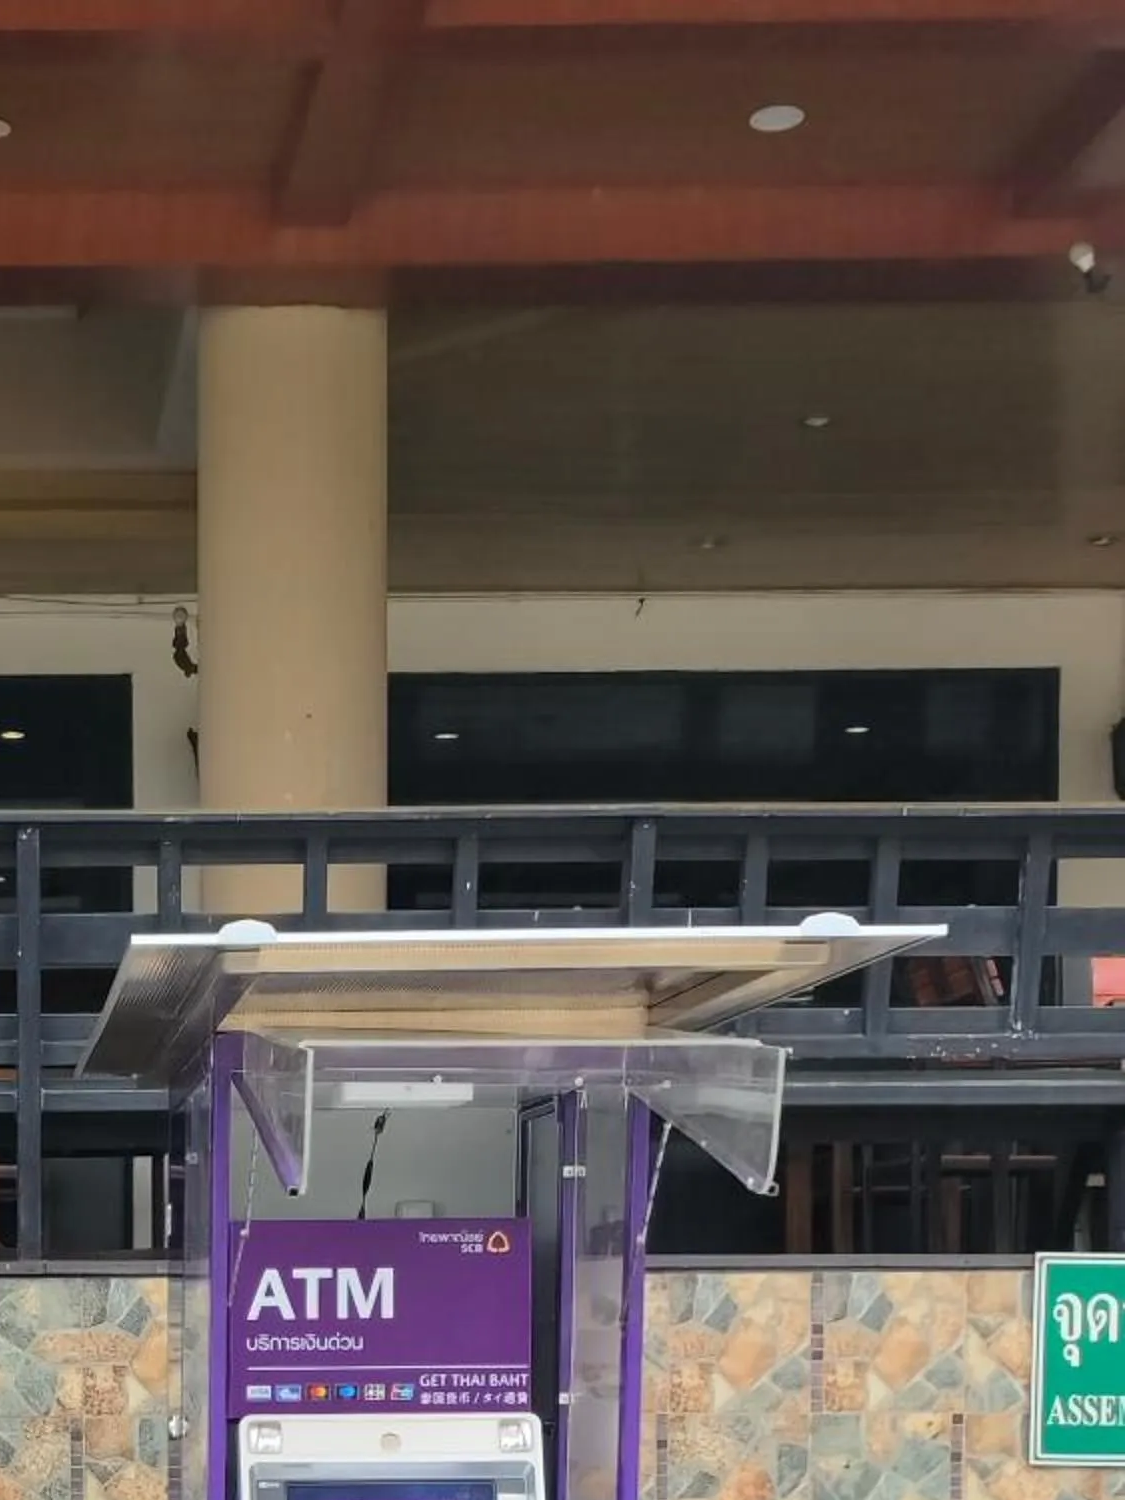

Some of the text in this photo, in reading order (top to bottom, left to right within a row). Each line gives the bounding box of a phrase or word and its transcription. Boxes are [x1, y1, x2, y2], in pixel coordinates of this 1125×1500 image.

[246, 1267, 395, 1321] ATM
[246, 1331, 364, 1351] บริการเงินด่วน
[1052, 1292, 1125, 1368] จุด
[420, 1373, 530, 1387] GET THAI BAHT
